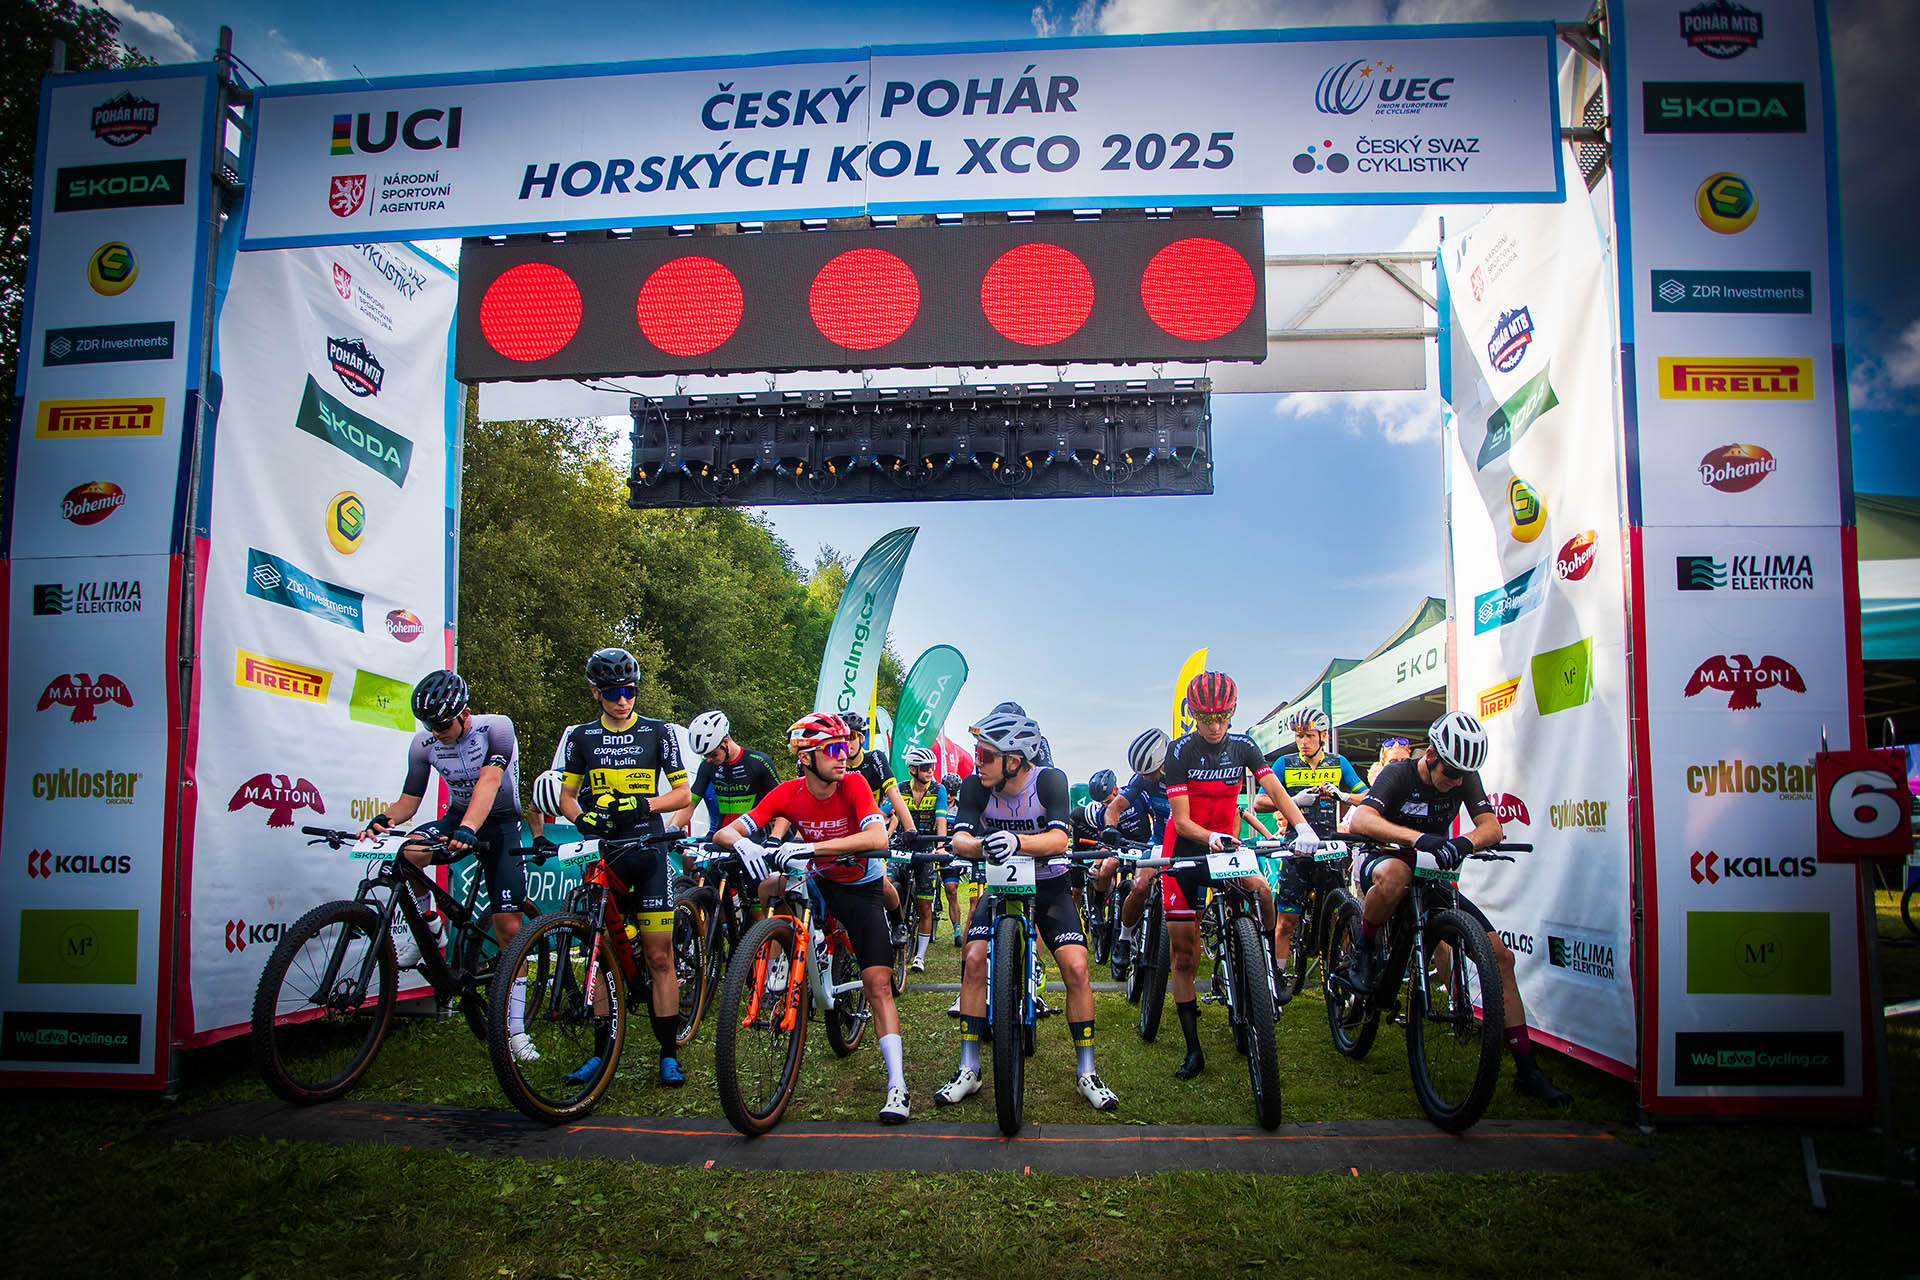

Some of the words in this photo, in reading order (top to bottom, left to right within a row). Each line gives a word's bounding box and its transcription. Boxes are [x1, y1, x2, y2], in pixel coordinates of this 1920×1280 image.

[700, 82, 865, 131] ČESKÝ
[879, 65, 1079, 118] POHÁR
[1379, 77, 1455, 102] UEC
[356, 106, 462, 154] UCI
[1356, 135, 1422, 154] ČESKÝ
[1428, 138, 1480, 154] SVAZ
[383, 170, 439, 185] NÁRODNÍ
[518, 141, 804, 201] HORSKÝCH
[826, 138, 940, 184] KOL
[956, 133, 1081, 176] XCO
[1101, 131, 1235, 172] 2025
[1357, 157, 1470, 173] CYKLISTIKY
[382, 184, 451, 199] SPORTOVNÍ
[380, 200, 445, 213] AGENTURA
[1692, 285, 1720, 298] ZDR
[1724, 285, 1805, 298] Investments
[76, 340, 99, 351] ZDR
[102, 336, 168, 349] Investments
[330, 342, 363, 373] POHÁR
[364, 363, 381, 385] MTB
[1673, 365, 1800, 392] PIRELLI
[48, 404, 154, 431] PIRELLI
[1698, 457, 1777, 485] Bohemia
[62, 493, 126, 519] Bohemia
[1732, 555, 1814, 577] KLIMA
[77, 581, 142, 602] KLIMA
[1732, 577, 1814, 590] ELEKTRON
[76, 600, 142, 614] ELEKTRON
[286, 576, 305, 597] ZDR
[305, 582, 359, 618] Investments
[386, 618, 425, 634] Bohemia
[837, 591, 877, 712] Cycling.cz
[246, 658, 323, 698] PIRELLI
[1700, 669, 1790, 682] MATTONI
[50, 686, 121, 699] MATTONI
[32, 768, 138, 801] cyklostar
[1187, 765, 1245, 780] SPECIALIZED
[1687, 759, 1816, 797] cyklostar
[244, 786, 316, 804] MATTONI
[1829, 770, 1903, 840] 6
[1550, 799, 1608, 830] cyklostar
[1006, 865, 1017, 882] 2
[1228, 856, 1240, 868] 4
[527, 871, 557, 902] DR
[1573, 940, 1614, 967] KLIMA
[1573, 956, 1615, 981] ELEKTRON
